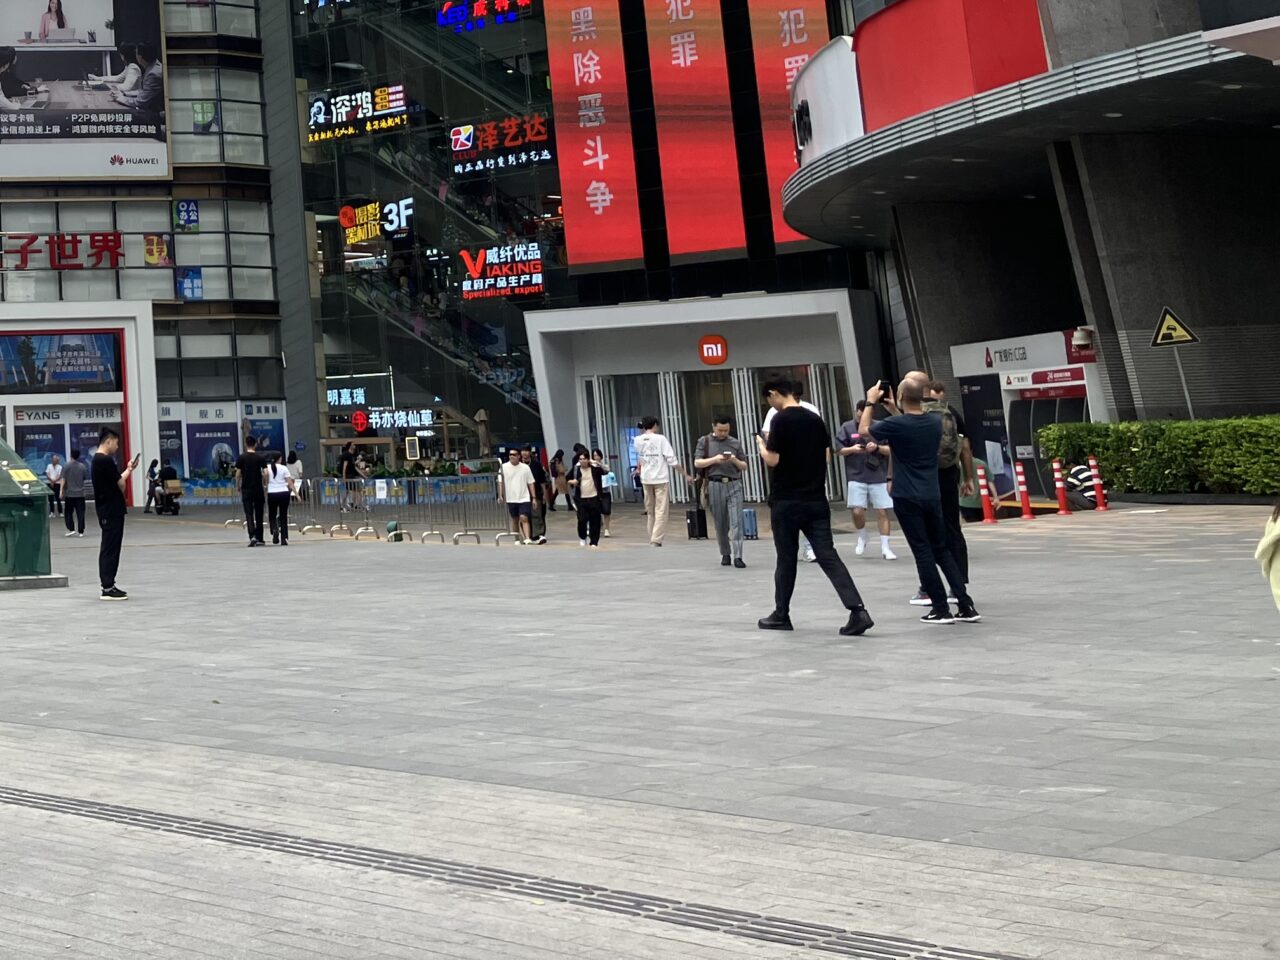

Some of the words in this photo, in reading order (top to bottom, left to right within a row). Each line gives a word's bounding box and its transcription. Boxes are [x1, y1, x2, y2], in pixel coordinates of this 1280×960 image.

[475, 112, 548, 151] 泽艺达
[125, 157, 159, 165] HUAWEI
[179, 202, 197, 211] OA
[382, 197, 414, 232] 3F
[463, 289, 512, 300] Specialized
[514, 285, 544, 296] export
[326, 387, 366, 406] 明嘉瑞
[16, 410, 61, 421] EYANG
[74, 408, 116, 420] 宇阳科技
[368, 410, 434, 429] 书亦烧仙草
